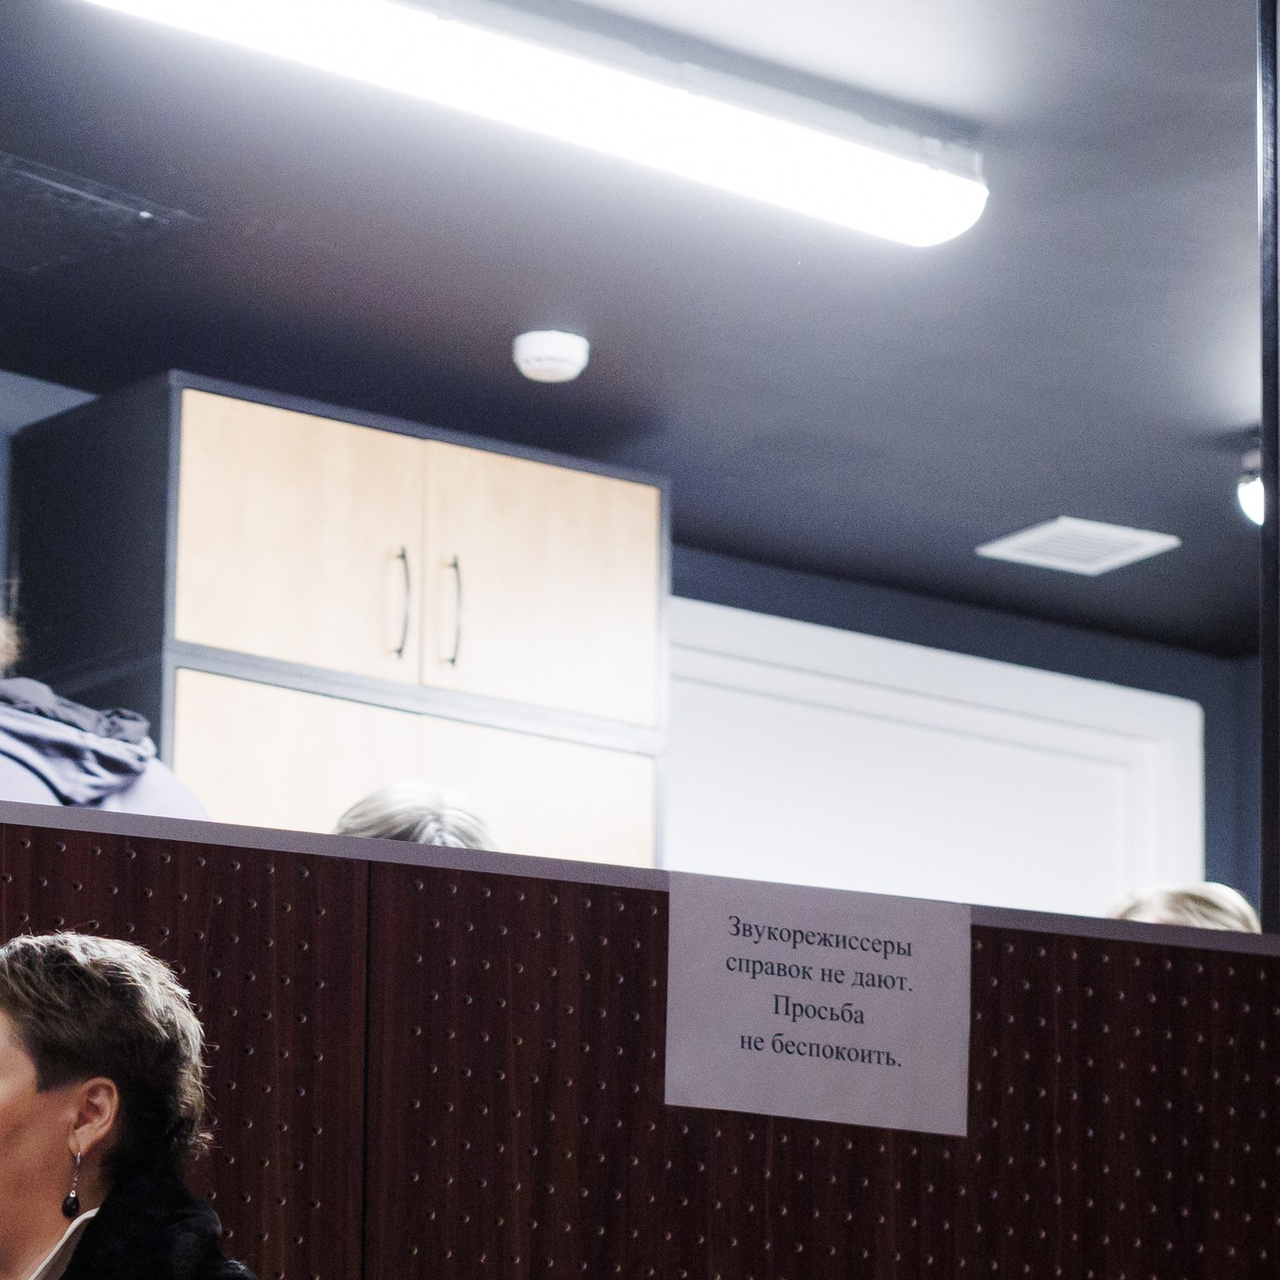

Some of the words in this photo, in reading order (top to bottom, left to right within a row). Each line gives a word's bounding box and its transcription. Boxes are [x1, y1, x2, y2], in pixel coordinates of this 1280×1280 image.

[728, 915, 913, 959] Звукорежиссеры
[726, 955, 813, 980] справок
[820, 967, 845, 984] не
[851, 970, 913, 992] дают.
[773, 994, 865, 1025] Просьба
[740, 1033, 765, 1051] не
[771, 1032, 902, 1068] беспокоить.
